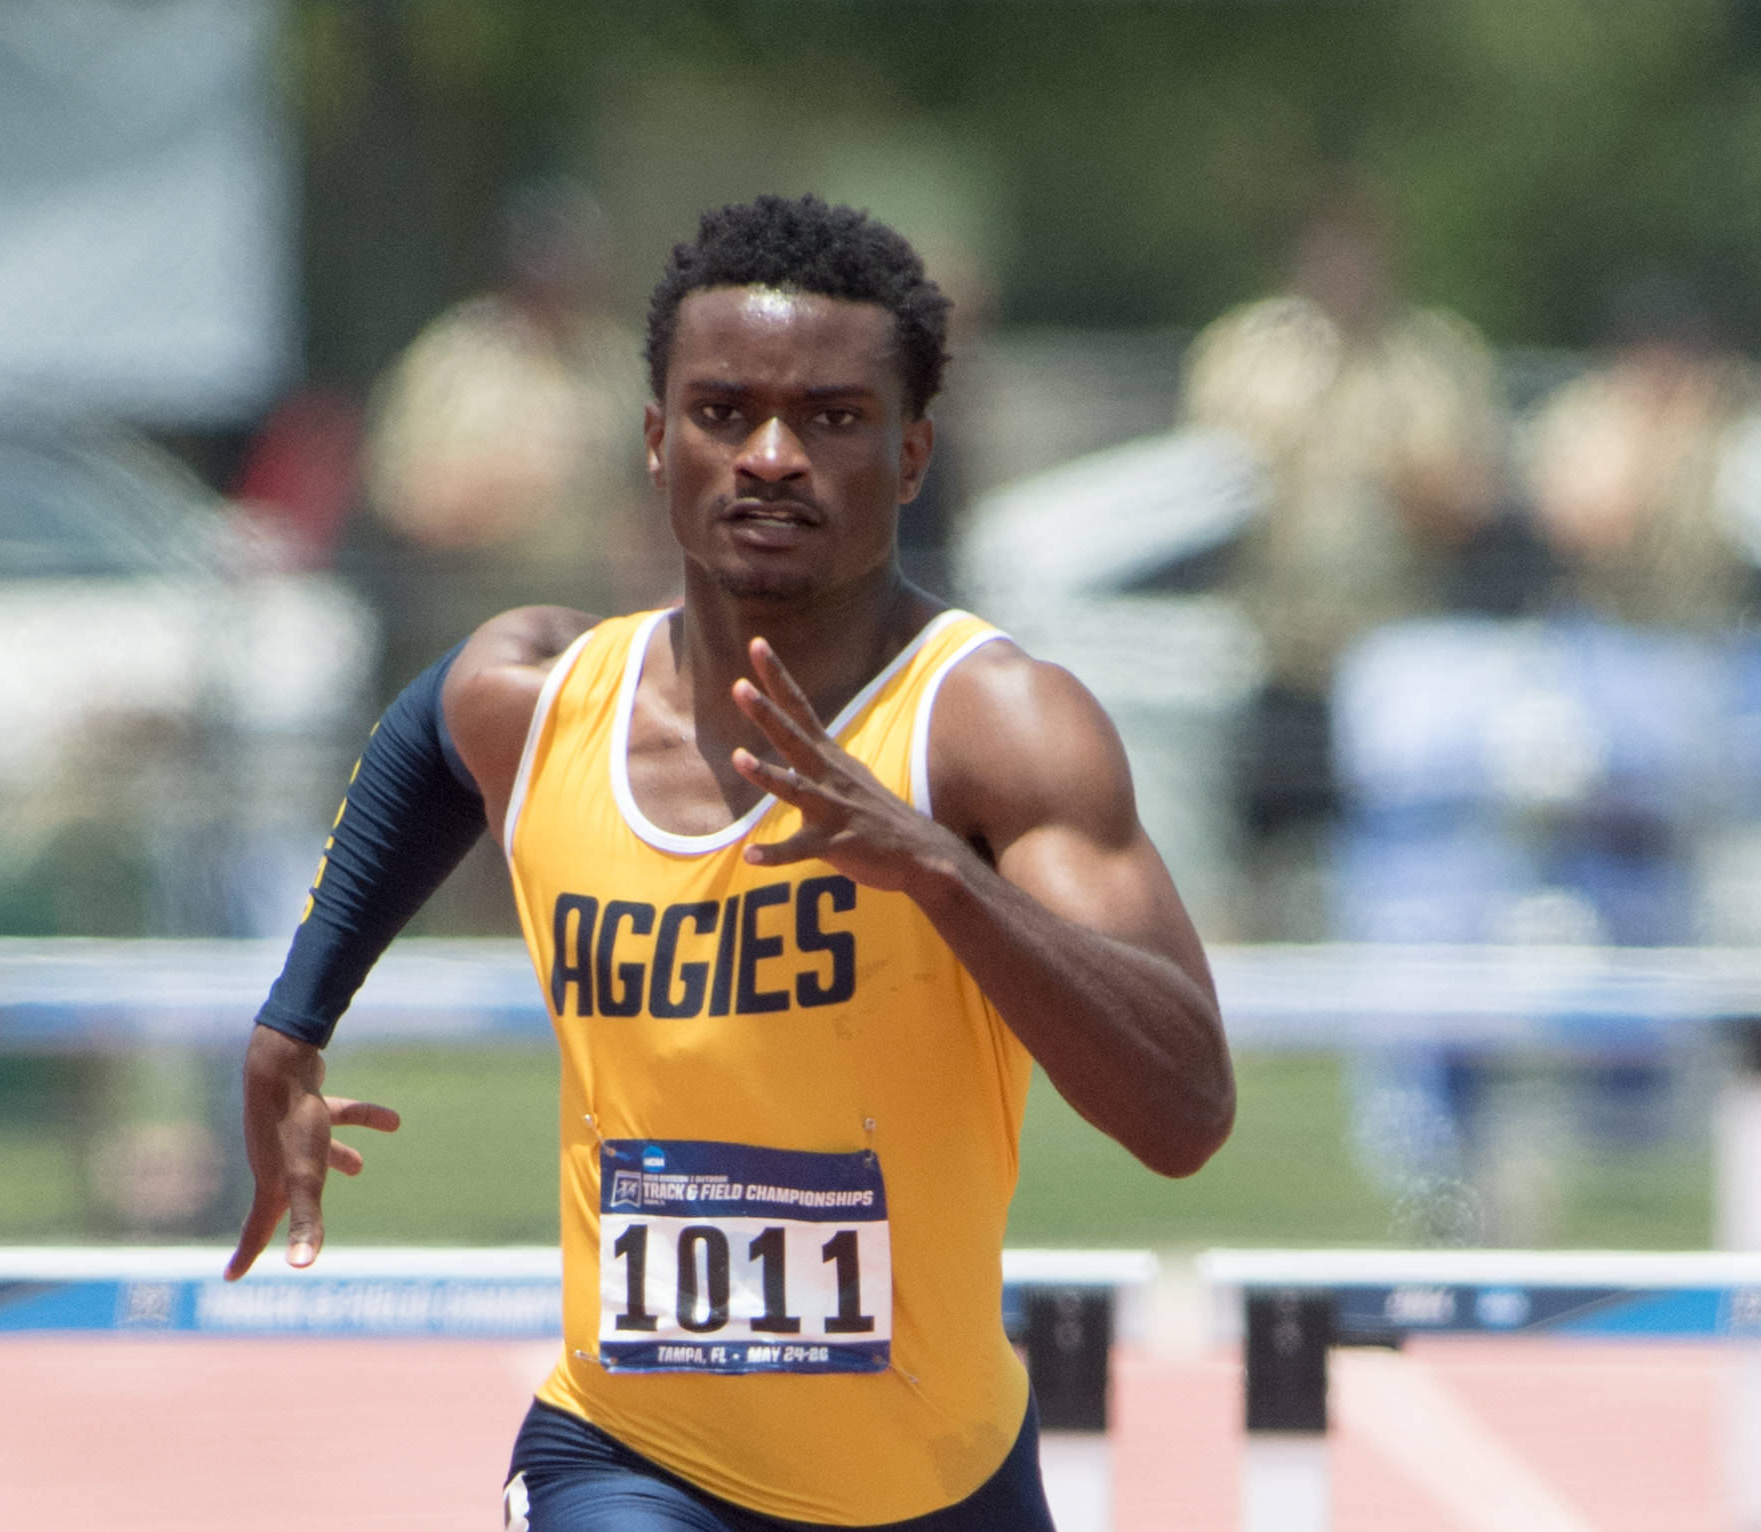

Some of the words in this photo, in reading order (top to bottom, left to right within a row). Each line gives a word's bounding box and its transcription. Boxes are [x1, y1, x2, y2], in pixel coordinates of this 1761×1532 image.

[551, 874, 858, 1020] AGGIES
[642, 1181, 686, 1201] TRACK
[700, 1183, 743, 1201] FIELD
[745, 1184, 874, 1207] CHAMPIONSHIPS
[614, 1224, 875, 1334] 1011
[657, 1345, 706, 1364] TAMPA,
[710, 1346, 727, 1363] FL
[746, 1346, 781, 1362] MAY
